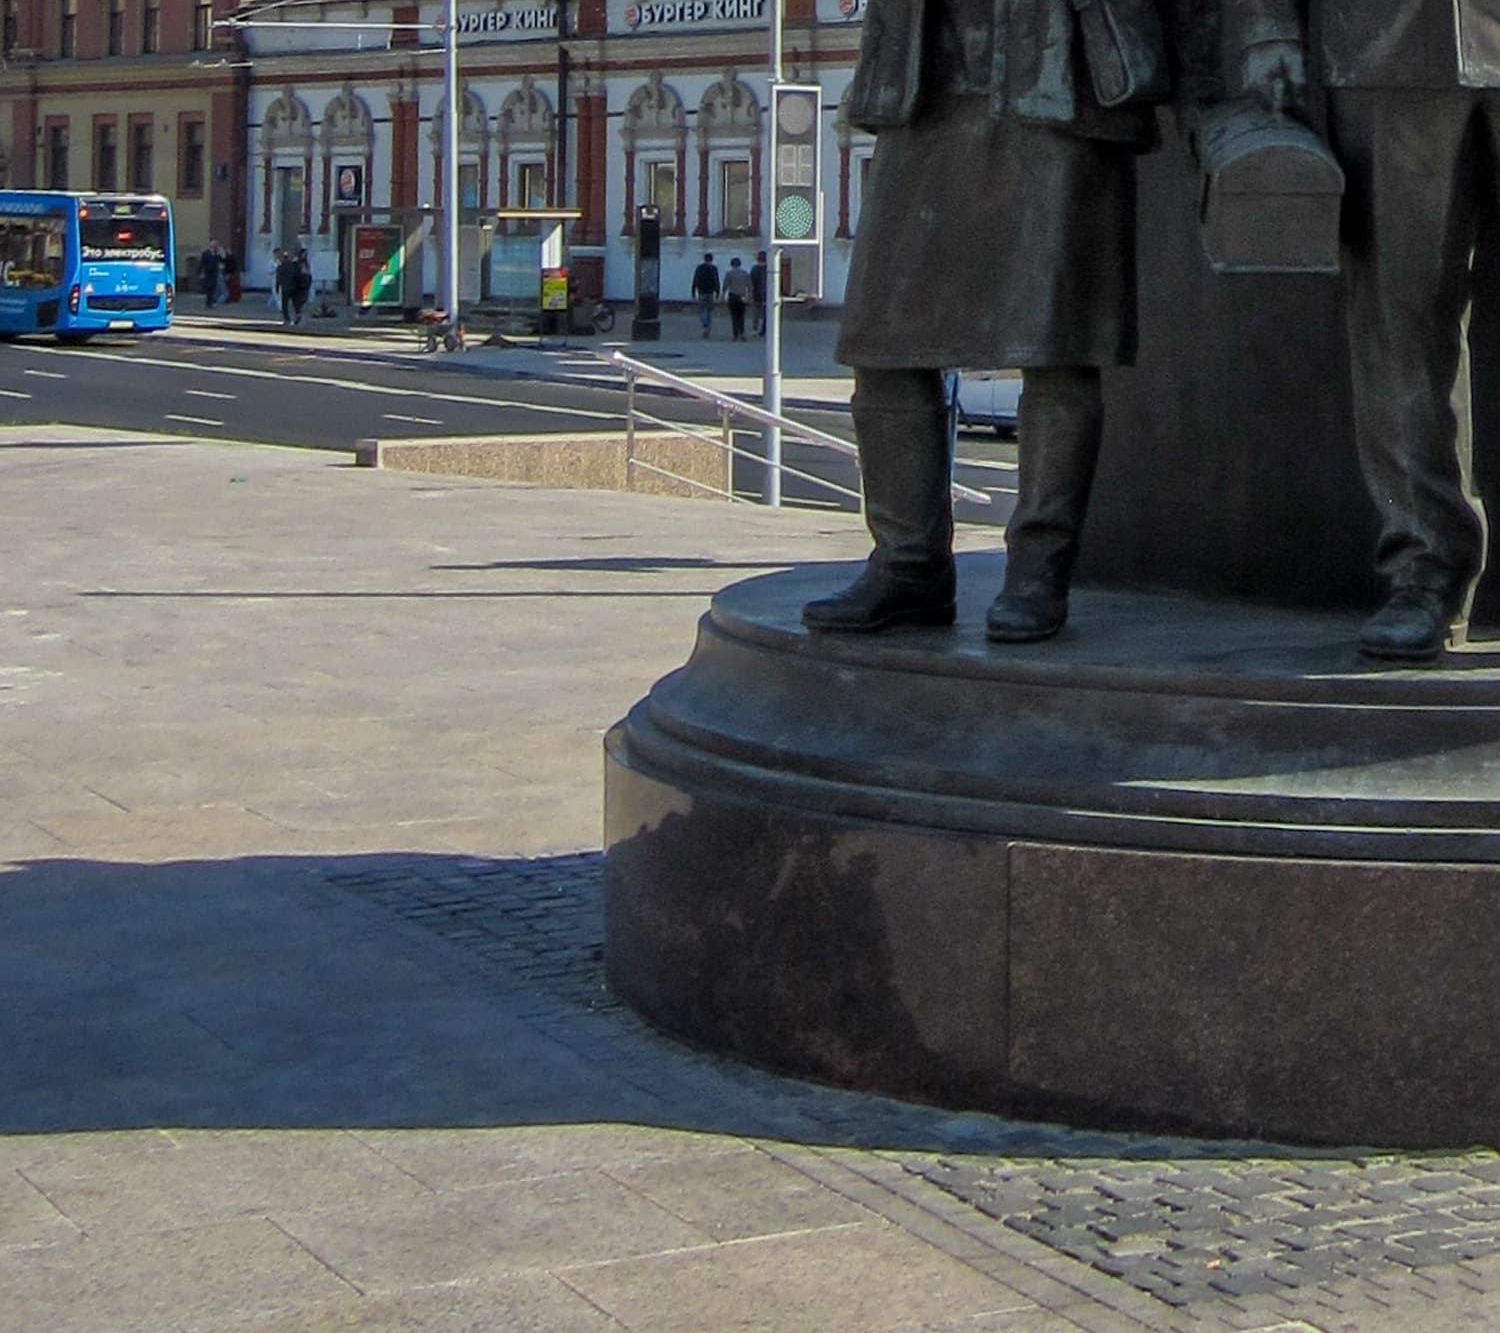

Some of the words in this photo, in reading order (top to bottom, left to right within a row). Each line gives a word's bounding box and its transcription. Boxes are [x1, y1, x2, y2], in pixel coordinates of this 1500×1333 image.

[457, 11, 507, 33] УРГЕР
[513, 7, 558, 30] КИНГ
[641, 2, 705, 25] БУРГЕР
